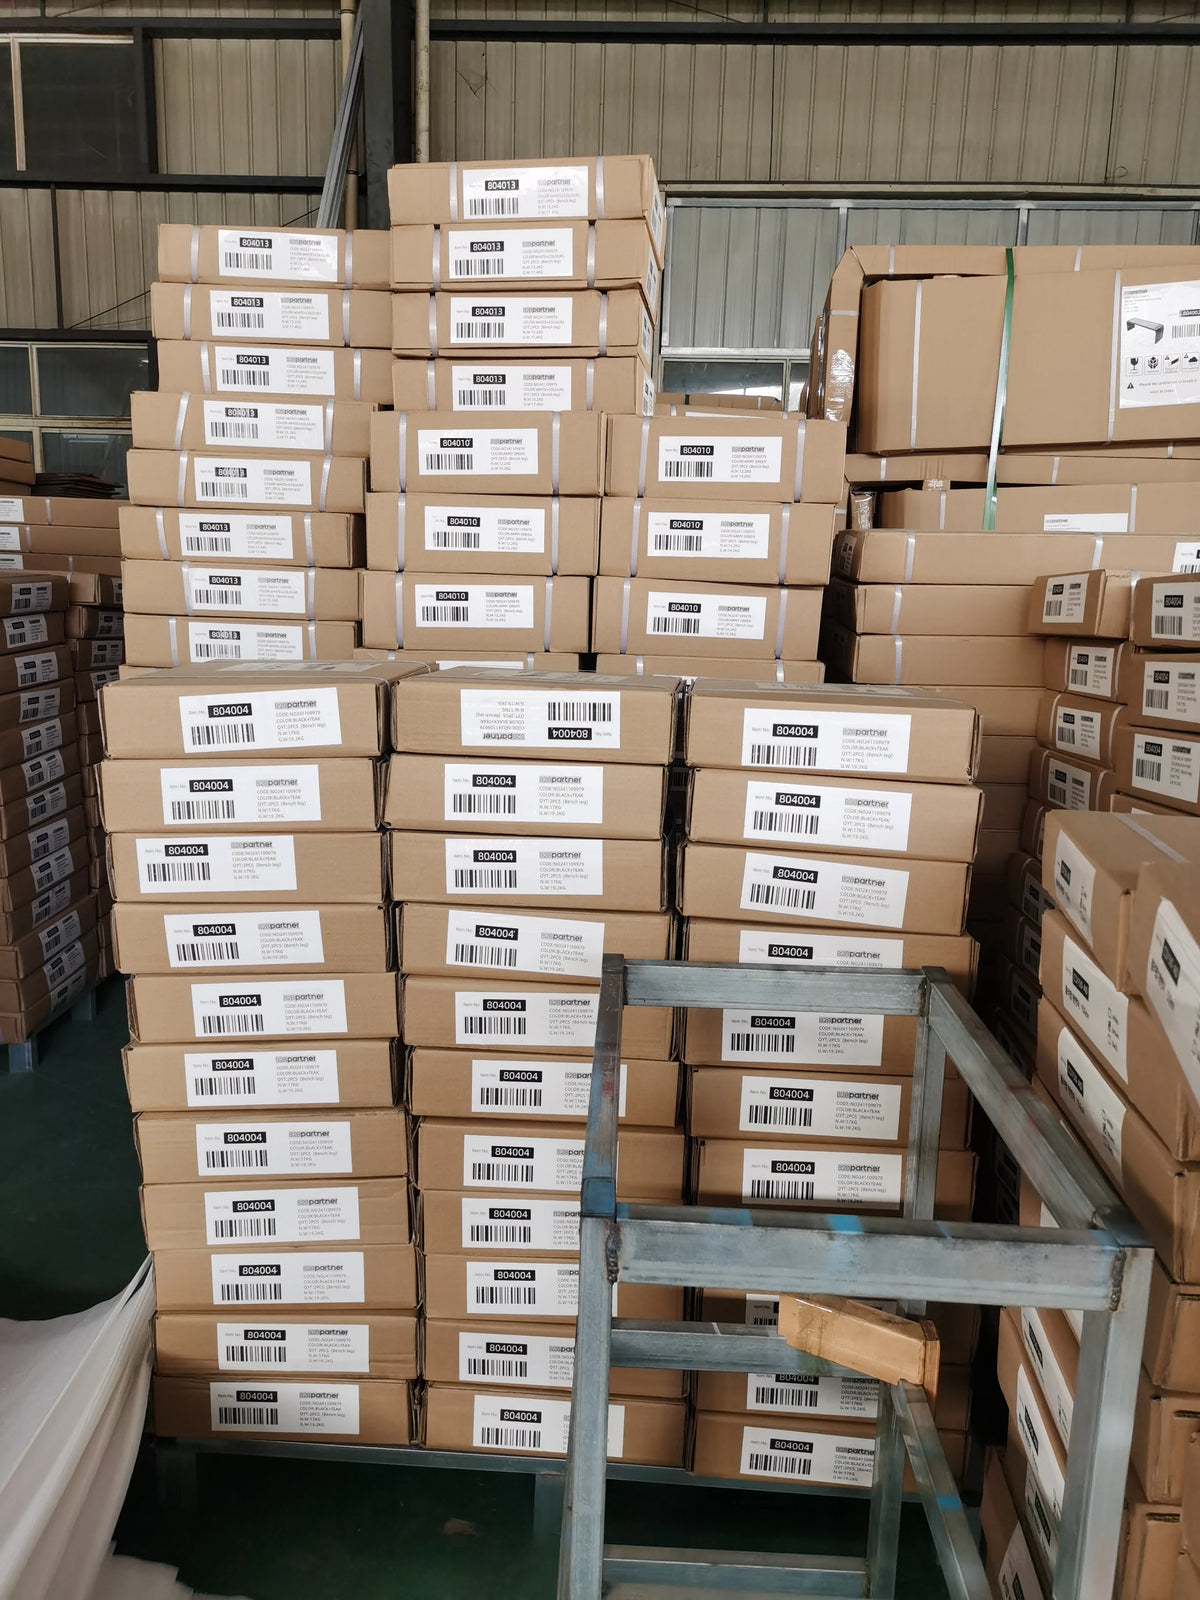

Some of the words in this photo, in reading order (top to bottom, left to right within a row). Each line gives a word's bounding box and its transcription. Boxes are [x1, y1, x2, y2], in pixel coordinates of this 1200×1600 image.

[487, 181, 515, 189] 804013
[242, 239, 269, 247] 804013
[472, 242, 500, 251] 804013
[239, 356, 265, 364] 804013
[475, 375, 502, 383] 804013
[683, 446, 710, 454] 804010
[450, 517, 477, 525] 804010
[202, 523, 227, 531] 804013
[211, 576, 238, 584] 804013
[671, 603, 698, 612] 804010
[212, 705, 248, 716] 804004
[551, 729, 588, 737] 804004
[776, 725, 814, 736] 804004
[193, 781, 229, 790] 804004
[476, 776, 512, 786] 804004
[779, 794, 816, 806] 804004
[168, 845, 204, 855] 804004
[477, 851, 513, 861] 804004
[777, 868, 814, 881] 804004
[197, 925, 232, 934] 804004
[478, 927, 514, 939] 804004
[771, 946, 809, 957] 804004
[222, 996, 257, 1005] 804004
[487, 1001, 521, 1009] 804004
[754, 1018, 791, 1026] 804004
[215, 1060, 250, 1069] 804004
[503, 1071, 538, 1081] 804004
[773, 1088, 809, 1099] 804004
[227, 1133, 262, 1142] 804004
[495, 1147, 530, 1157] 804004
[776, 1163, 812, 1172] 804004
[236, 1201, 271, 1210] 804004
[493, 1209, 527, 1218] 804004
[242, 1266, 277, 1274] 804004
[497, 1271, 531, 1279] 804004
[489, 1344, 523, 1353] 804004
[240, 1392, 273, 1400] 804004
[503, 1411, 537, 1421] 804004
[774, 1440, 810, 1451] 804004
